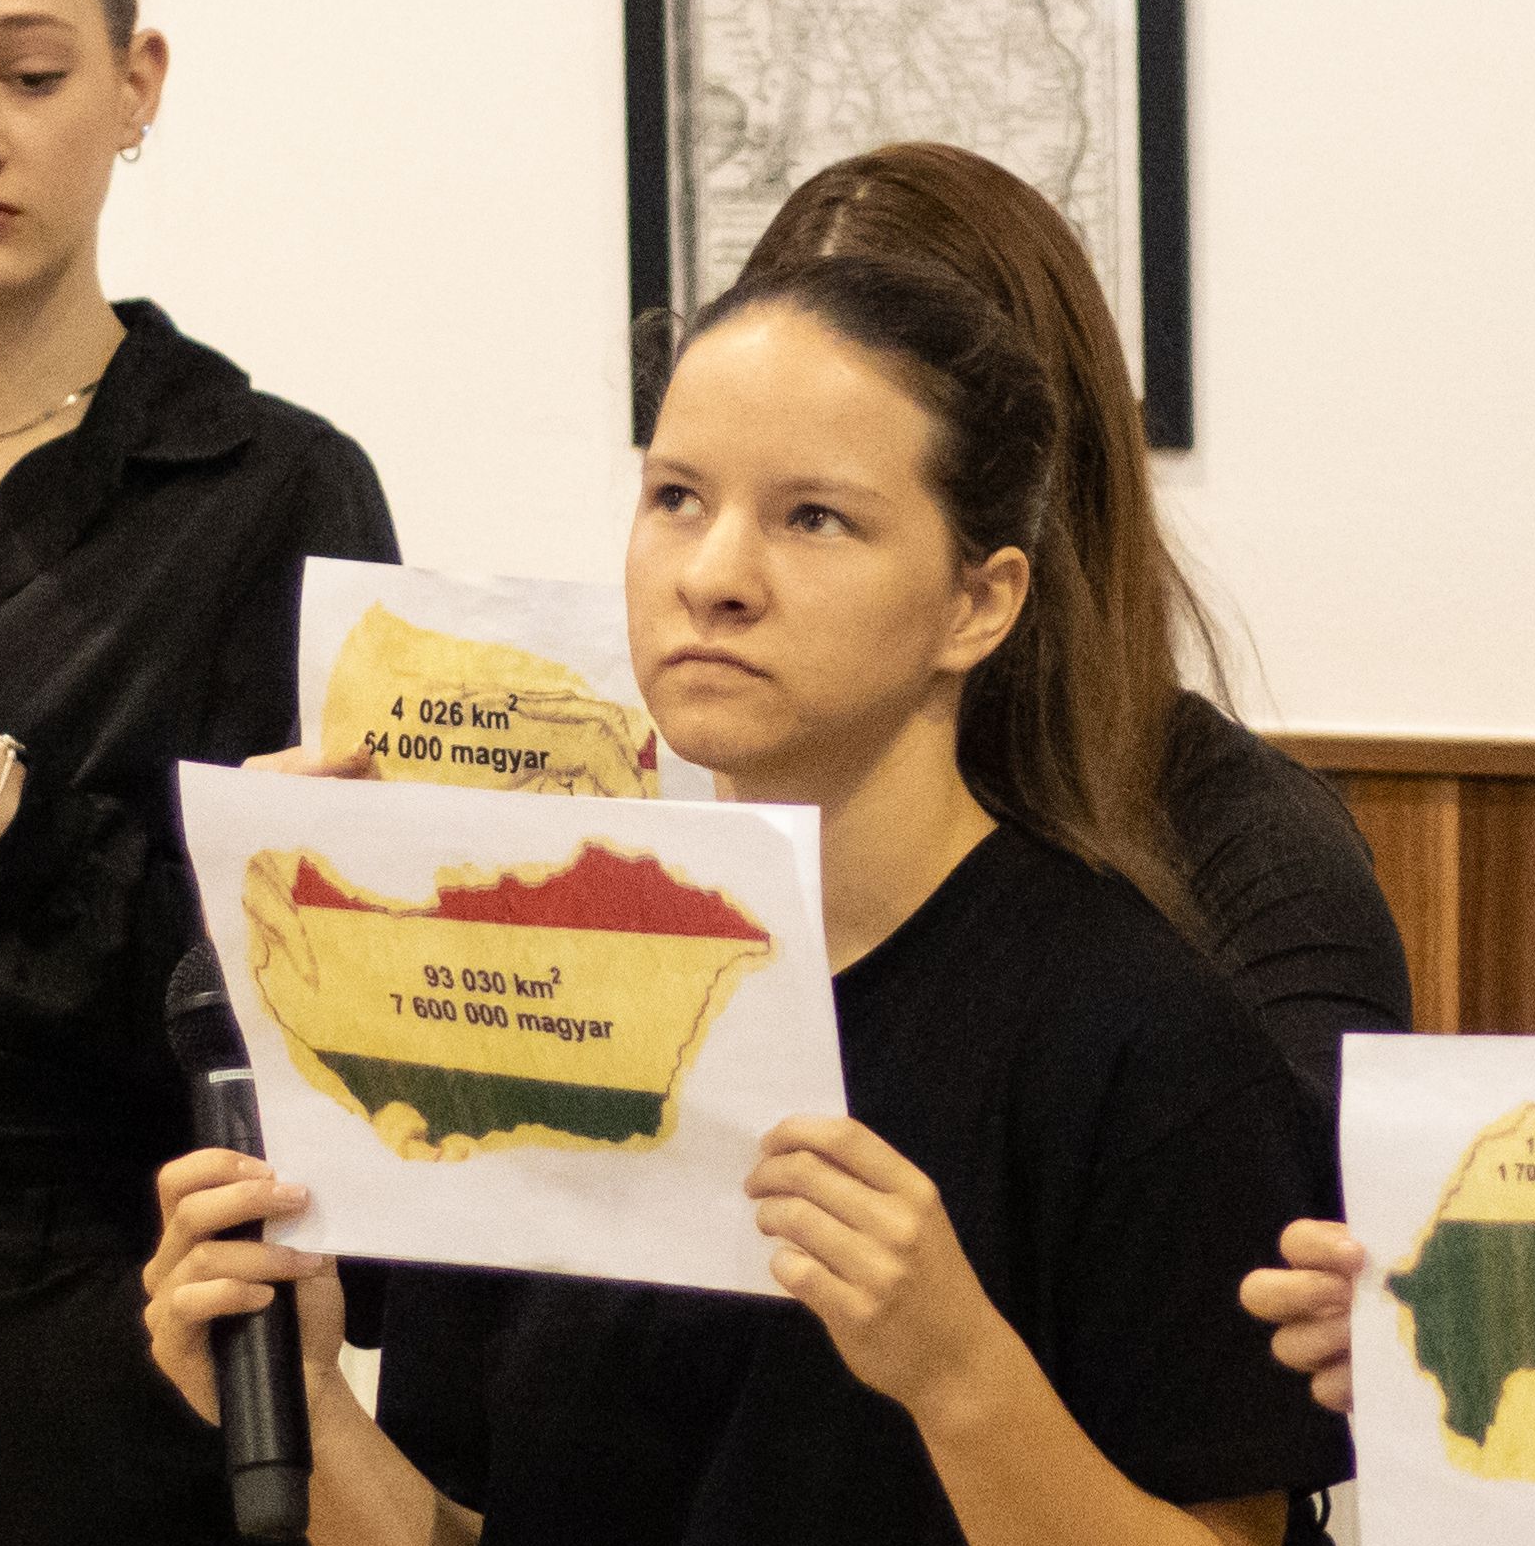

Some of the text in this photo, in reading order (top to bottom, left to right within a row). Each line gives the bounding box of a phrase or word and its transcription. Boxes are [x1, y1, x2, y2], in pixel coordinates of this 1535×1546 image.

[390, 697, 405, 720] 4
[419, 700, 464, 726] 026
[399, 736, 443, 763] 000
[451, 743, 550, 772] magyar
[424, 964, 456, 991] 93
[462, 968, 507, 996] 030
[390, 994, 615, 1041] 7 600 000 magyar
[1498, 1163, 1507, 1181] 1
